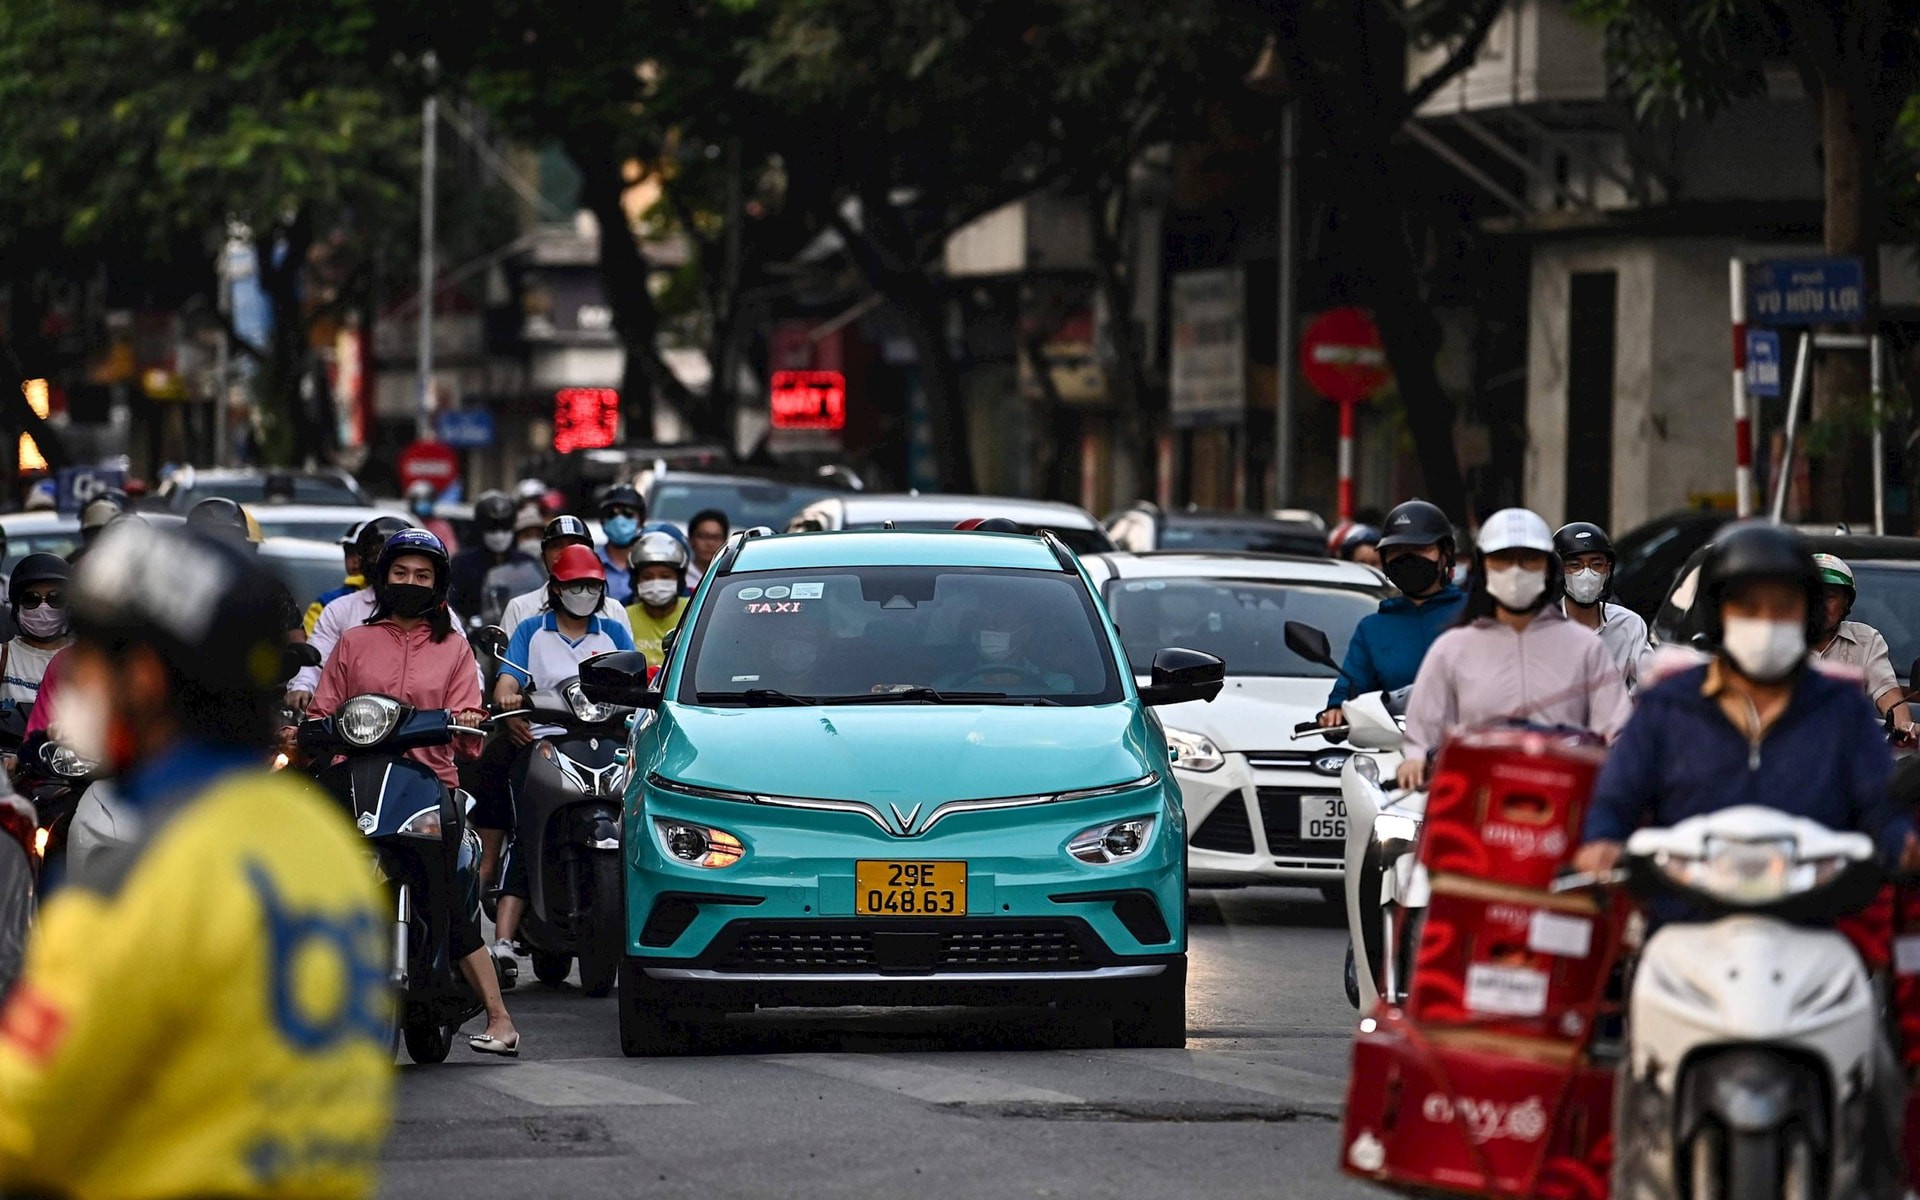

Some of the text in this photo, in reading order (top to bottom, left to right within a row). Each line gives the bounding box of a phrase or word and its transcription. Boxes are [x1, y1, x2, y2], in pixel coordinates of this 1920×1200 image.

[748, 602, 801, 614] TAXI
[1310, 820, 1346, 837] 056
[888, 864, 935, 886] 29E
[868, 890, 954, 913] 048.63
